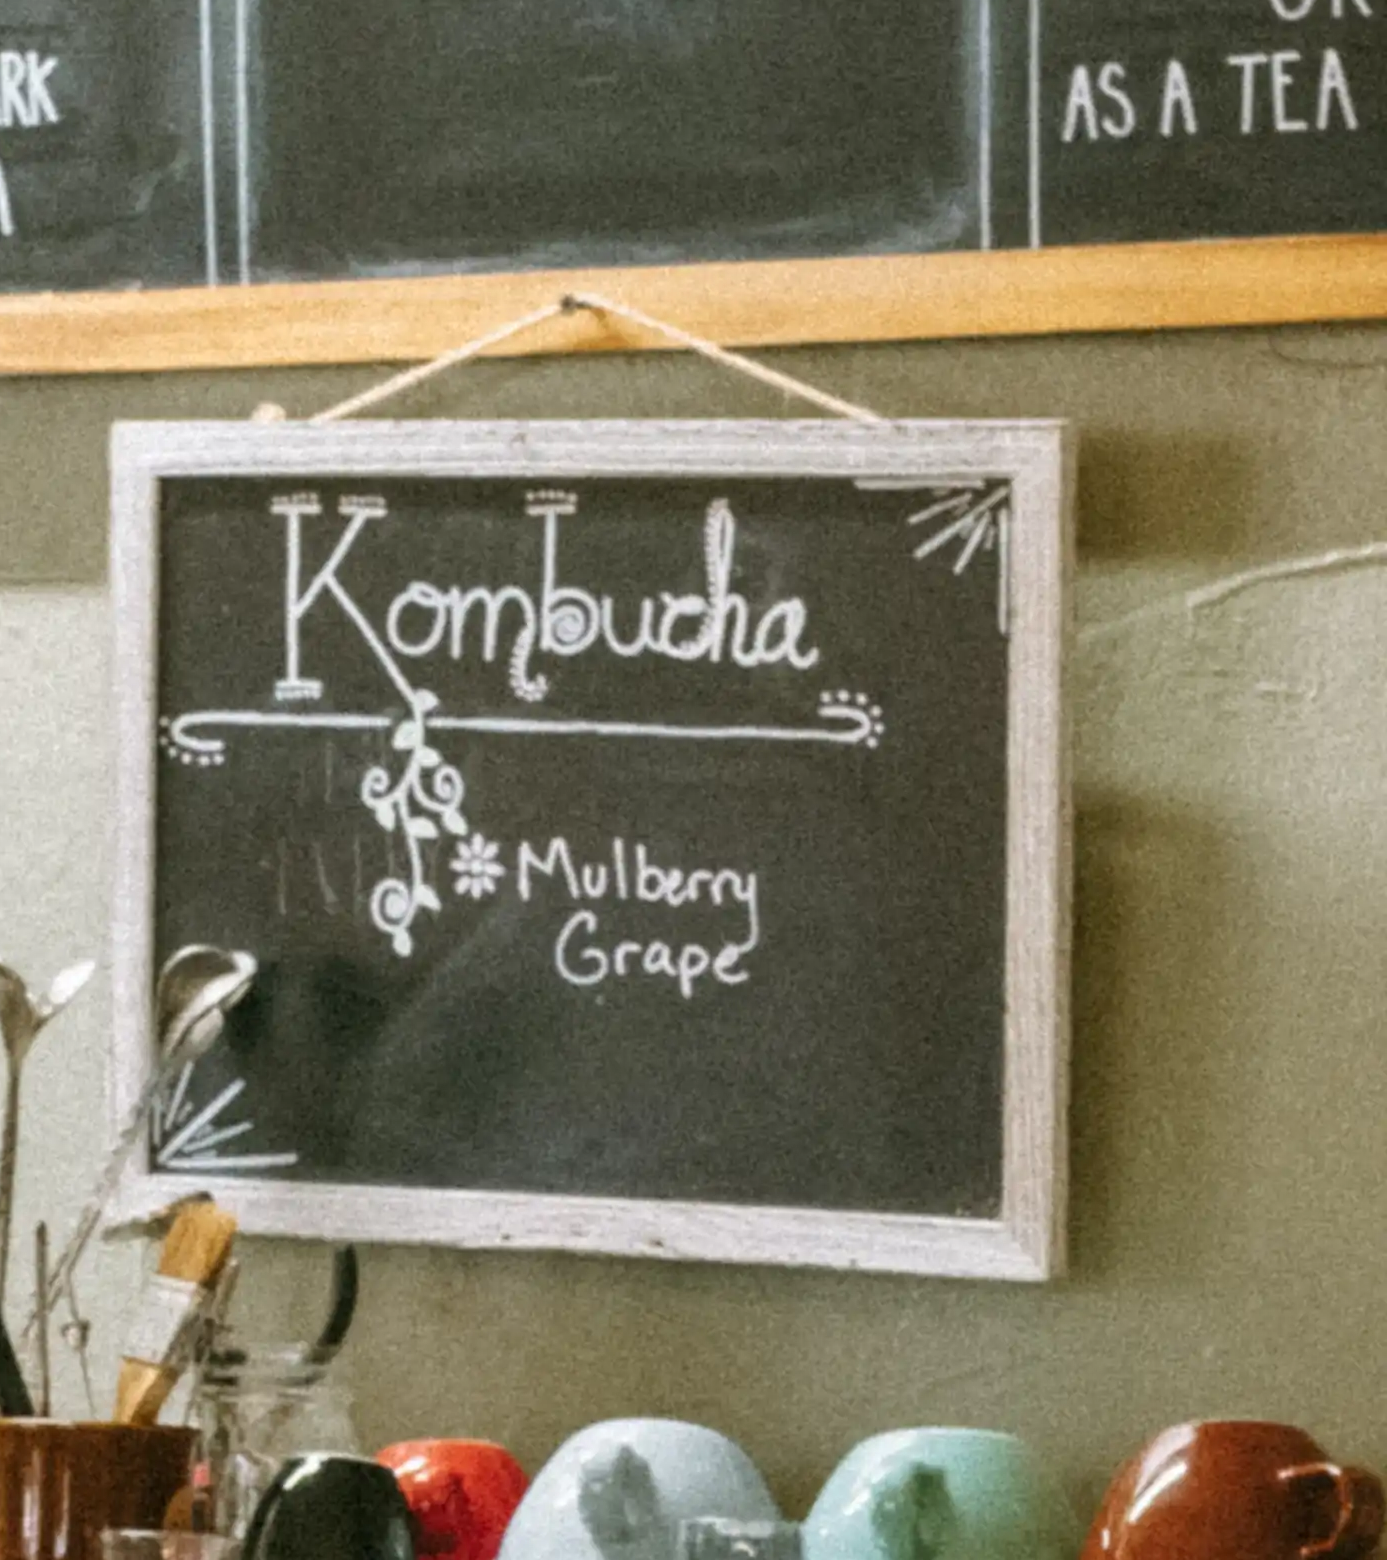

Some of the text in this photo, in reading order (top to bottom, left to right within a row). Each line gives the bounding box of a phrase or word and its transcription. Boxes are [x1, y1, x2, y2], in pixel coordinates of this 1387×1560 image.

[1062, 48, 1359, 142] AS A TEA
[271, 490, 820, 705] Kombucha
[517, 836, 759, 955] Mulberry
[554, 910, 752, 998] Grape
